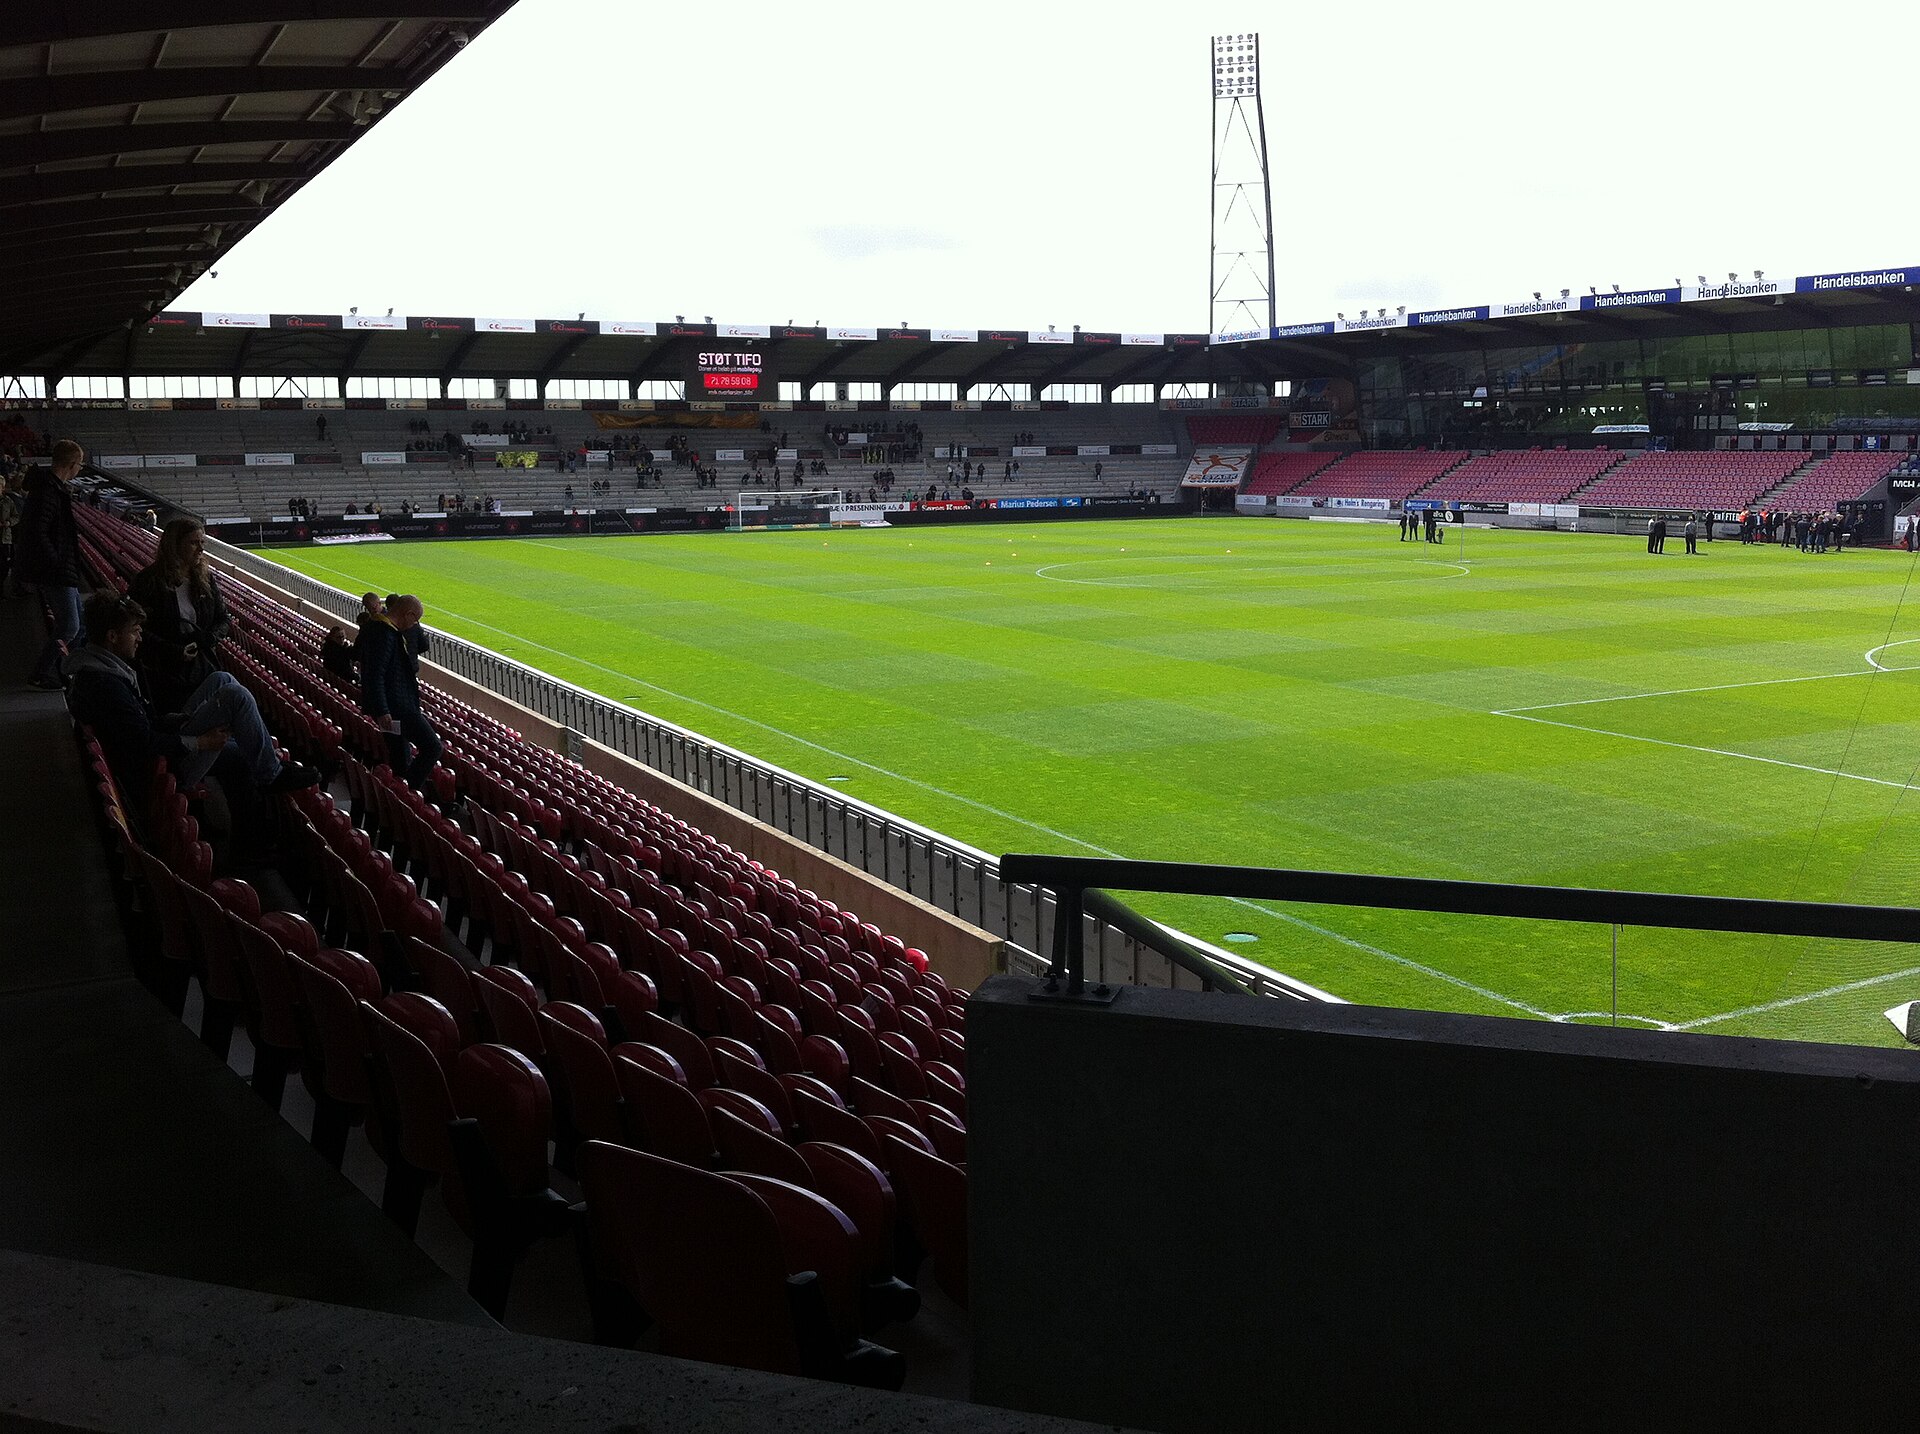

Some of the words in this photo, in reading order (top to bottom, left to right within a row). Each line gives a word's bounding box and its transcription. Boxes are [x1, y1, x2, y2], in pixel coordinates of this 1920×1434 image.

[1814, 272, 1905, 289] Handelsbanken
[1698, 282, 1777, 298] Handelsbanken
[1595, 292, 1666, 307] Handelsbanken
[1503, 300, 1567, 315] Handelsbanken
[1419, 310, 1476, 323] Handelsbanken
[1345, 317, 1396, 330] Handelsbanken
[1218, 330, 1261, 342] Handelsbanken
[1279, 324, 1325, 336] Handelsbanken
[698, 353, 732, 365] STØT
[734, 354, 762, 366] TIFO
[498, 387, 506, 398] 7
[838, 390, 846, 400] 8
[1177, 400, 1203, 409] STARK
[1232, 398, 1258, 407] STARK
[1302, 414, 1329, 426] STARK
[1893, 480, 1915, 488] MCH
[1026, 500, 1058, 508] Pedersen
